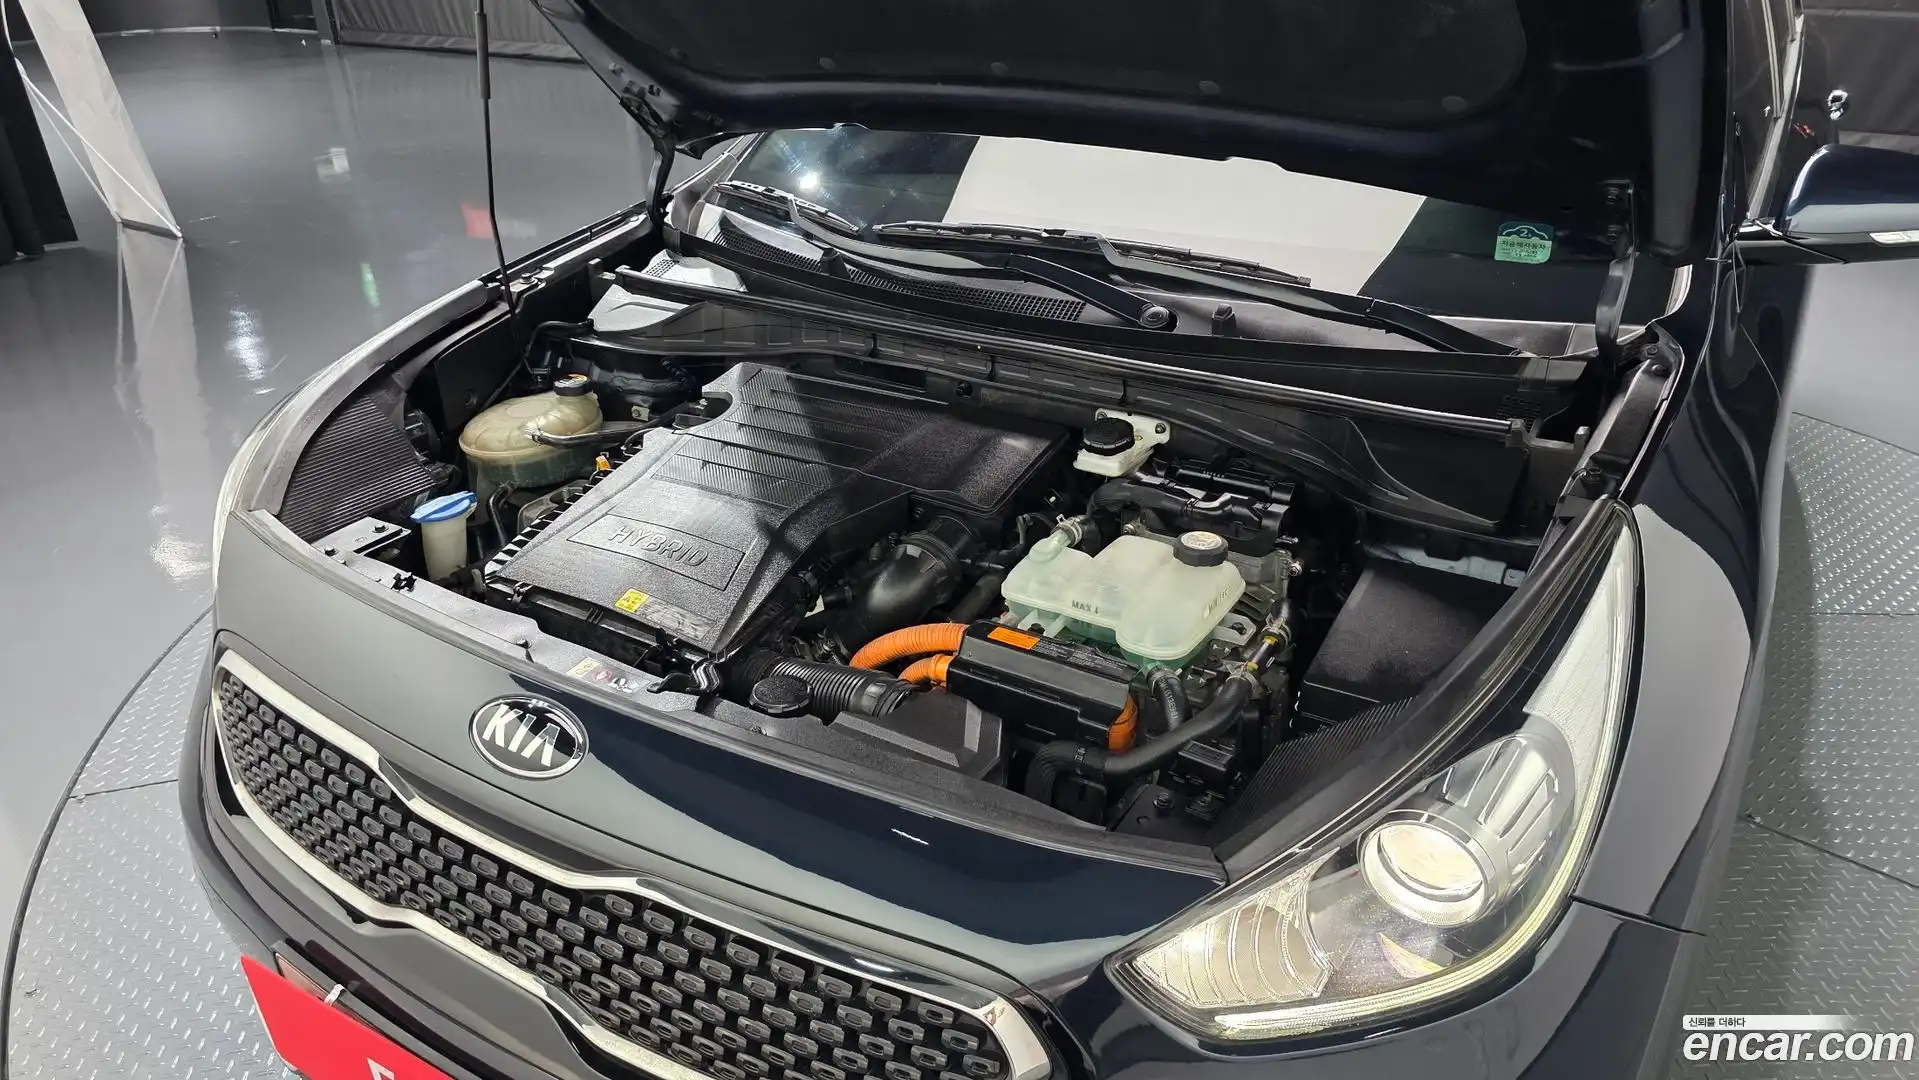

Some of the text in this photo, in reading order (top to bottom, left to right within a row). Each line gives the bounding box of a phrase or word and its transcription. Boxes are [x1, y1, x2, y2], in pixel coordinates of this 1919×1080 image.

[607, 525, 709, 567] HYBRID
[1071, 599, 1092, 613] MAX
[481, 703, 561, 767] KIA
